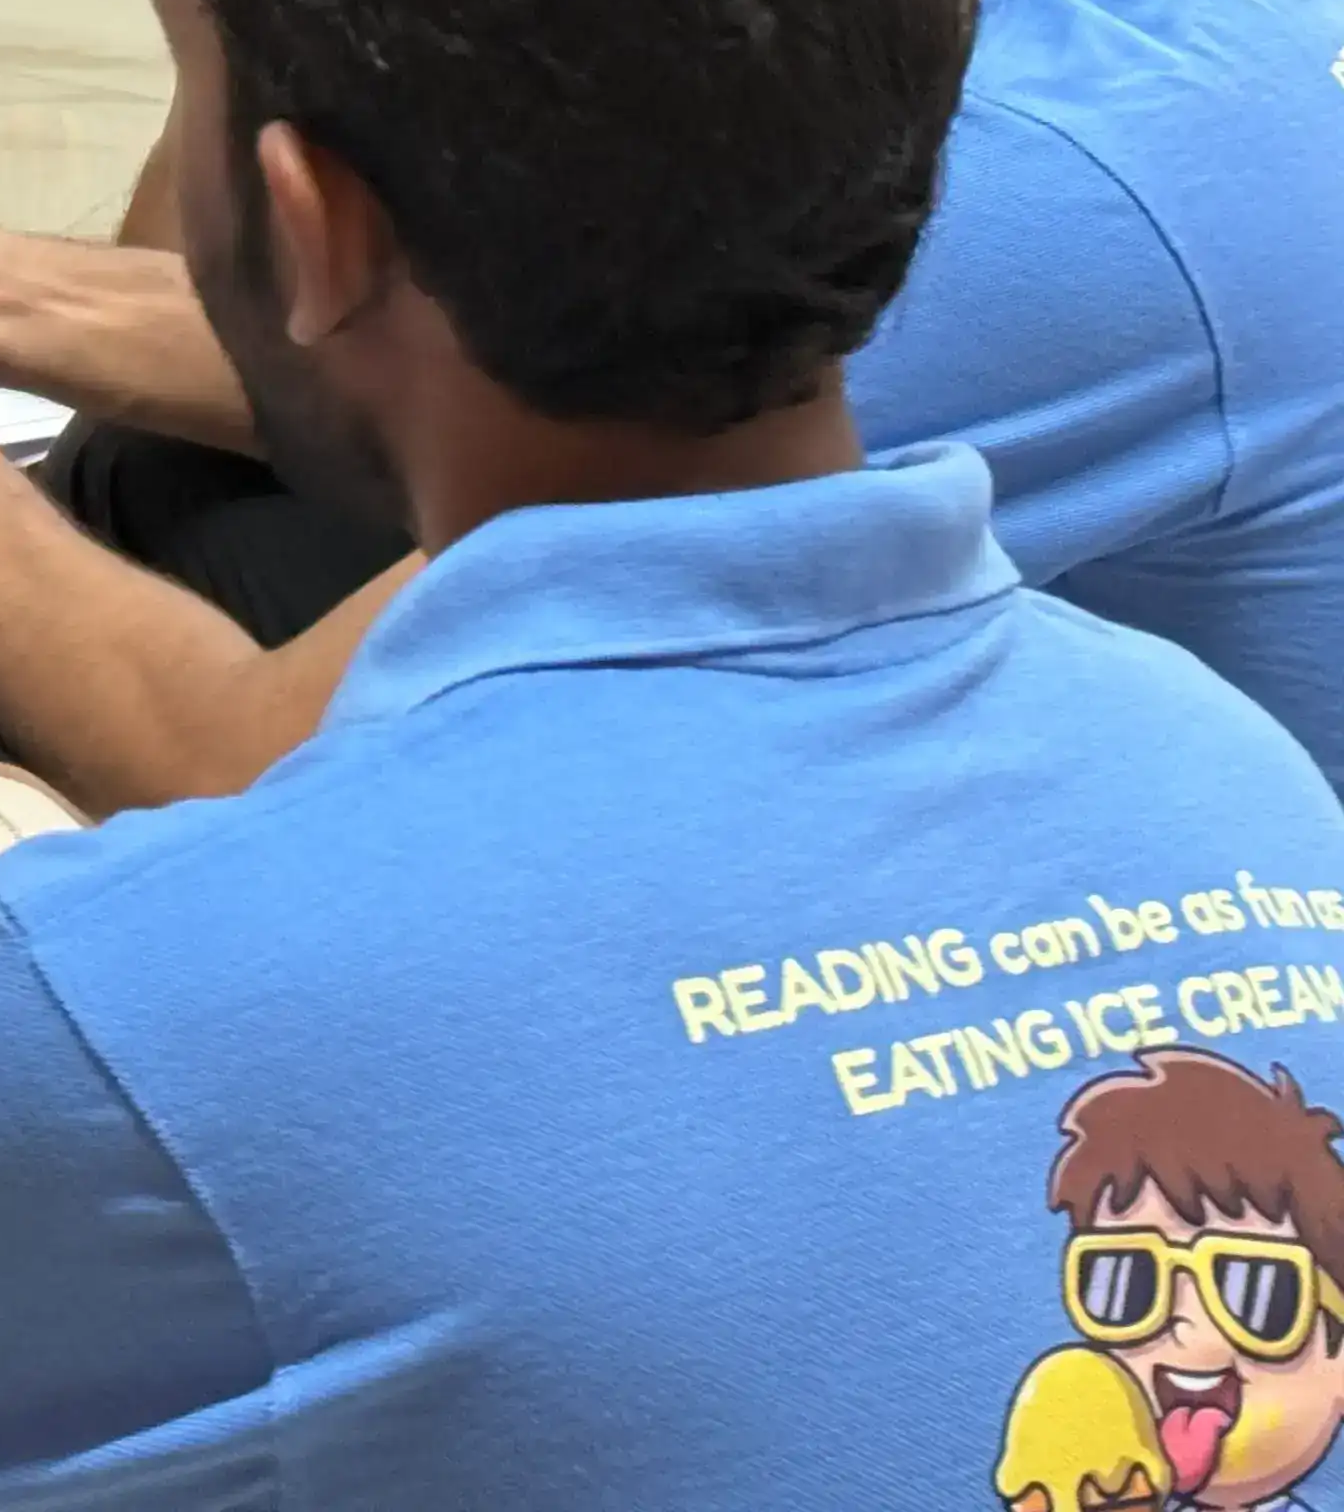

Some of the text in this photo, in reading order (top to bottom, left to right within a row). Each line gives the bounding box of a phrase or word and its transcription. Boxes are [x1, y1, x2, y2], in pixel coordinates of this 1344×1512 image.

[671, 926, 984, 1045] READING
[989, 915, 1102, 976] can
[1087, 892, 1180, 952] be
[1181, 888, 1246, 935] as
[1235, 869, 1316, 929] fun
[831, 1009, 1072, 1117] EATING
[1064, 983, 1180, 1061] ICE
